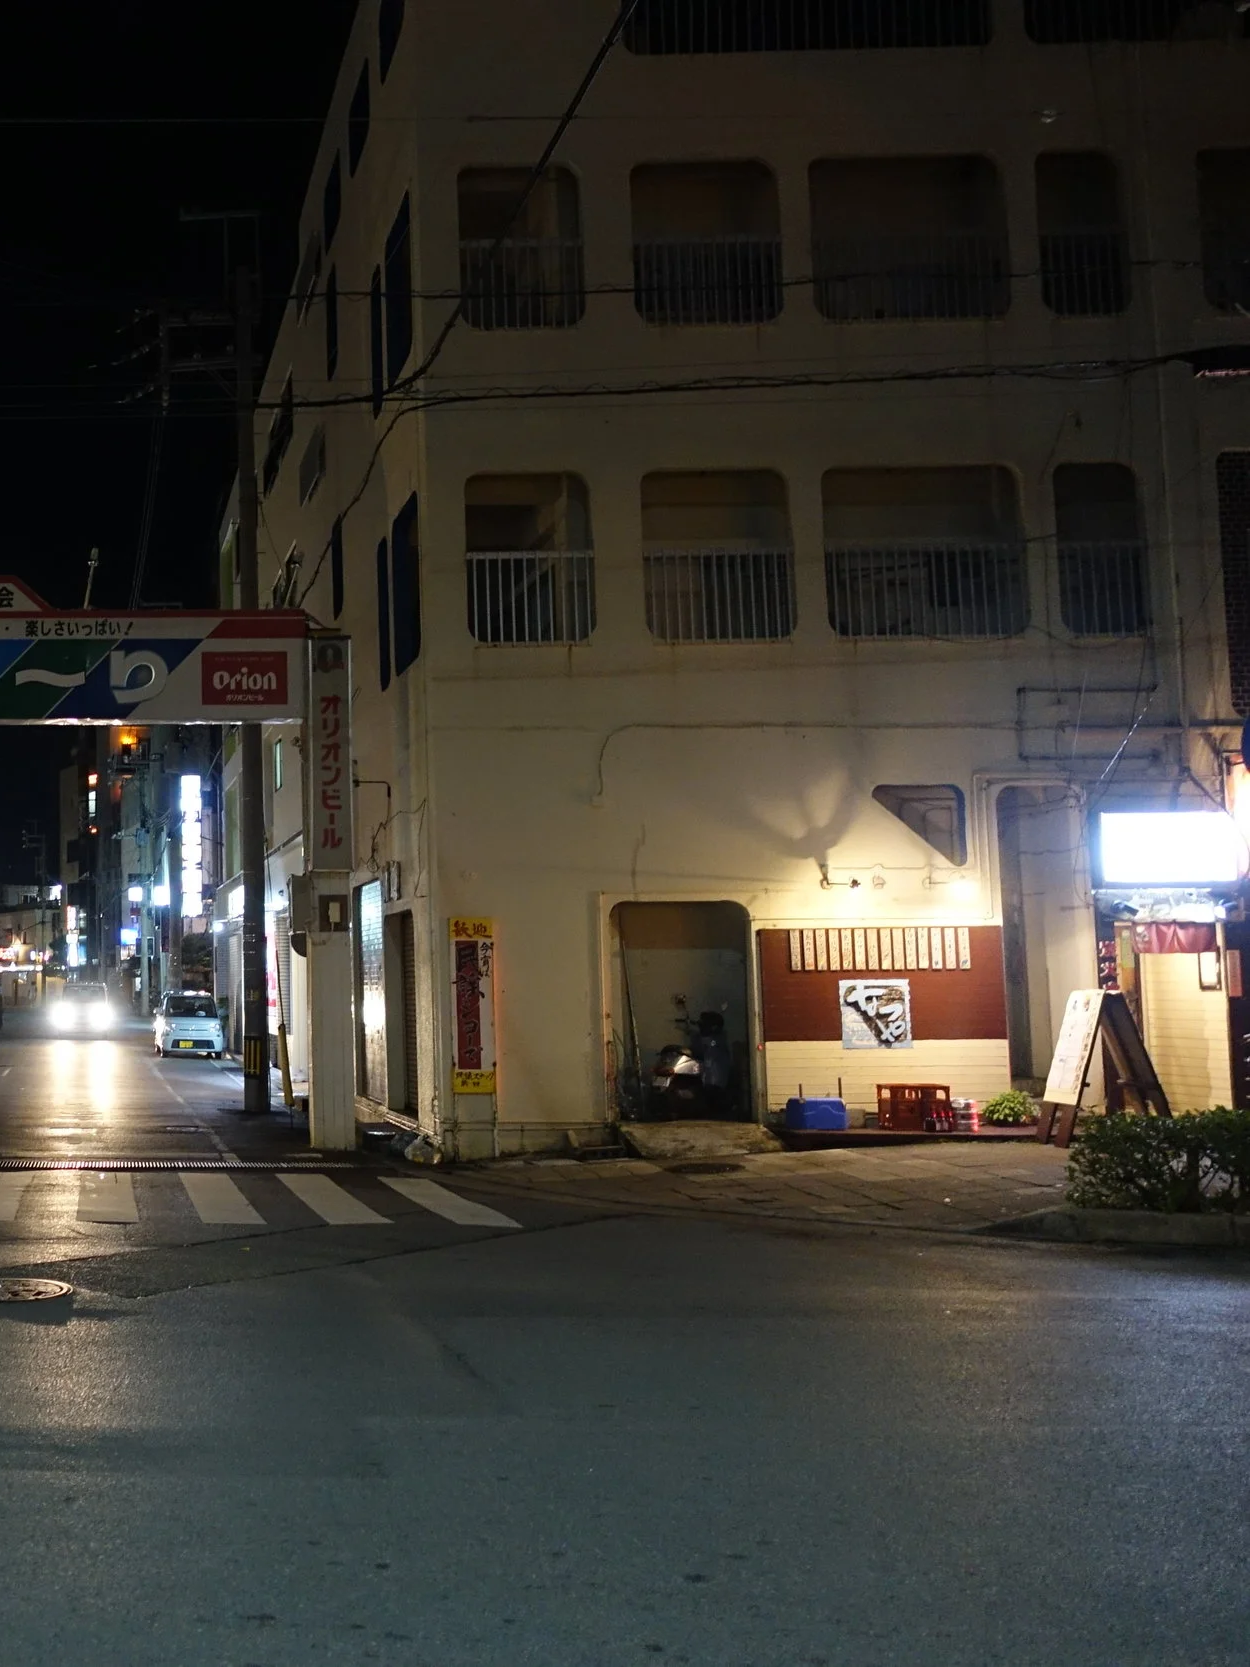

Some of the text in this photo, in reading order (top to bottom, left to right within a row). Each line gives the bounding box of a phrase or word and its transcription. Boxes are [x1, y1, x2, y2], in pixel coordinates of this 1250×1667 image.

[212, 666, 278, 691] Orion
[320, 693, 344, 850] オリオンビール
